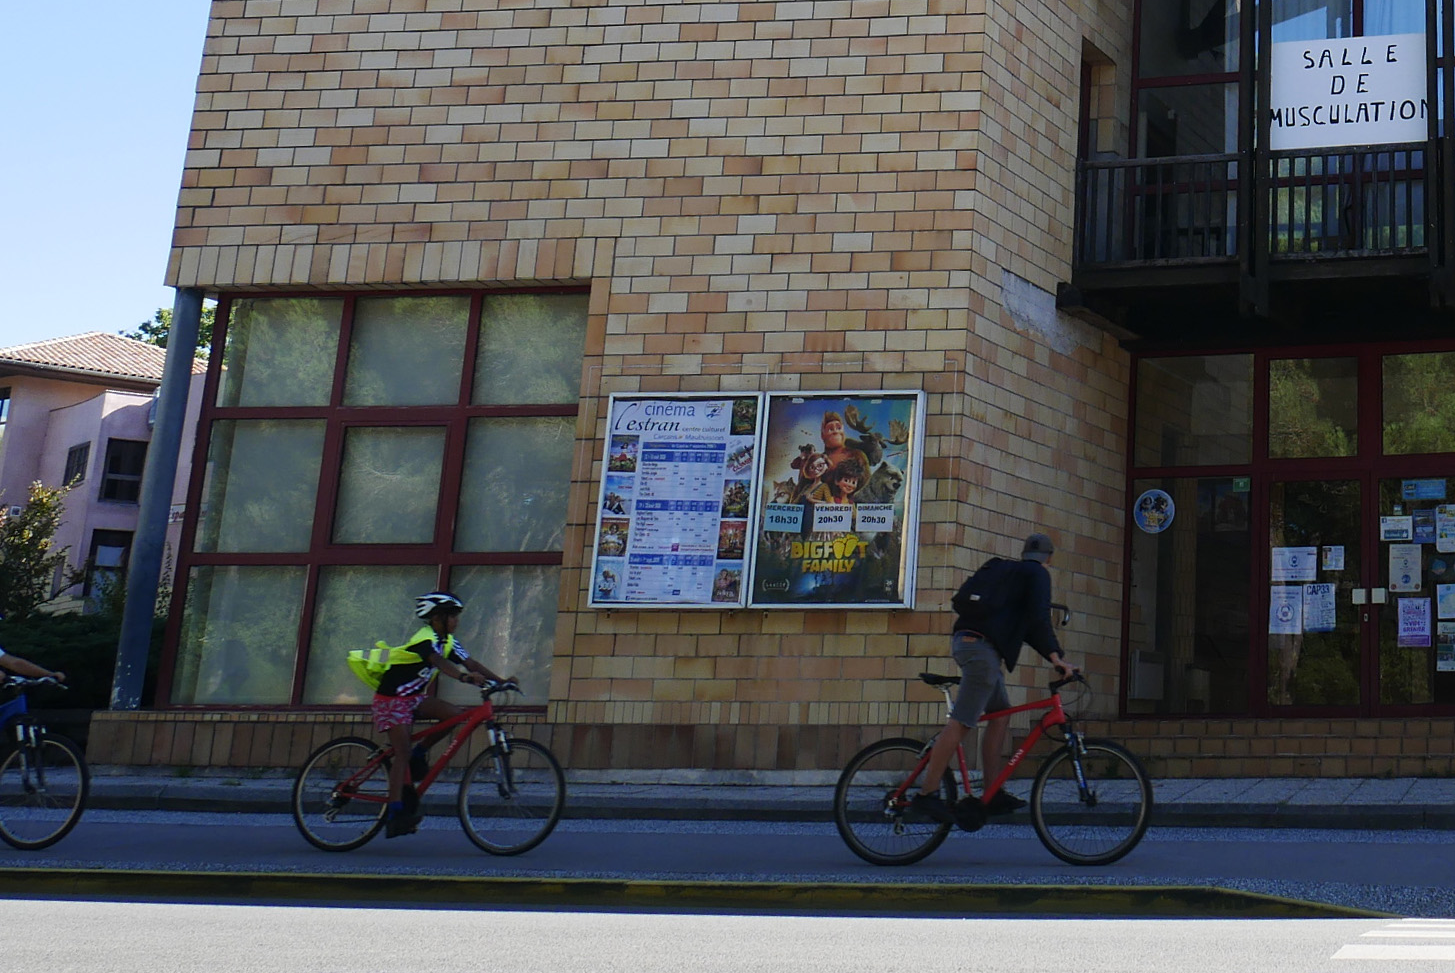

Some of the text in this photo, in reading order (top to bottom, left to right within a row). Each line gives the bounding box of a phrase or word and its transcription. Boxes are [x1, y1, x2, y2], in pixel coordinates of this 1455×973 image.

[1303, 44, 1398, 69] SALLE
[1330, 73, 1369, 95] DE
[644, 401, 695, 417] cinéma
[766, 504, 804, 512] MERCREDI
[857, 504, 893, 512] DIMANCHE
[769, 515, 798, 524] 18h30
[818, 515, 843, 524] 20h30
[861, 515, 886, 524] 20h30
[801, 559, 856, 573] FAMILY
[1306, 584, 1330, 595] CAP33
